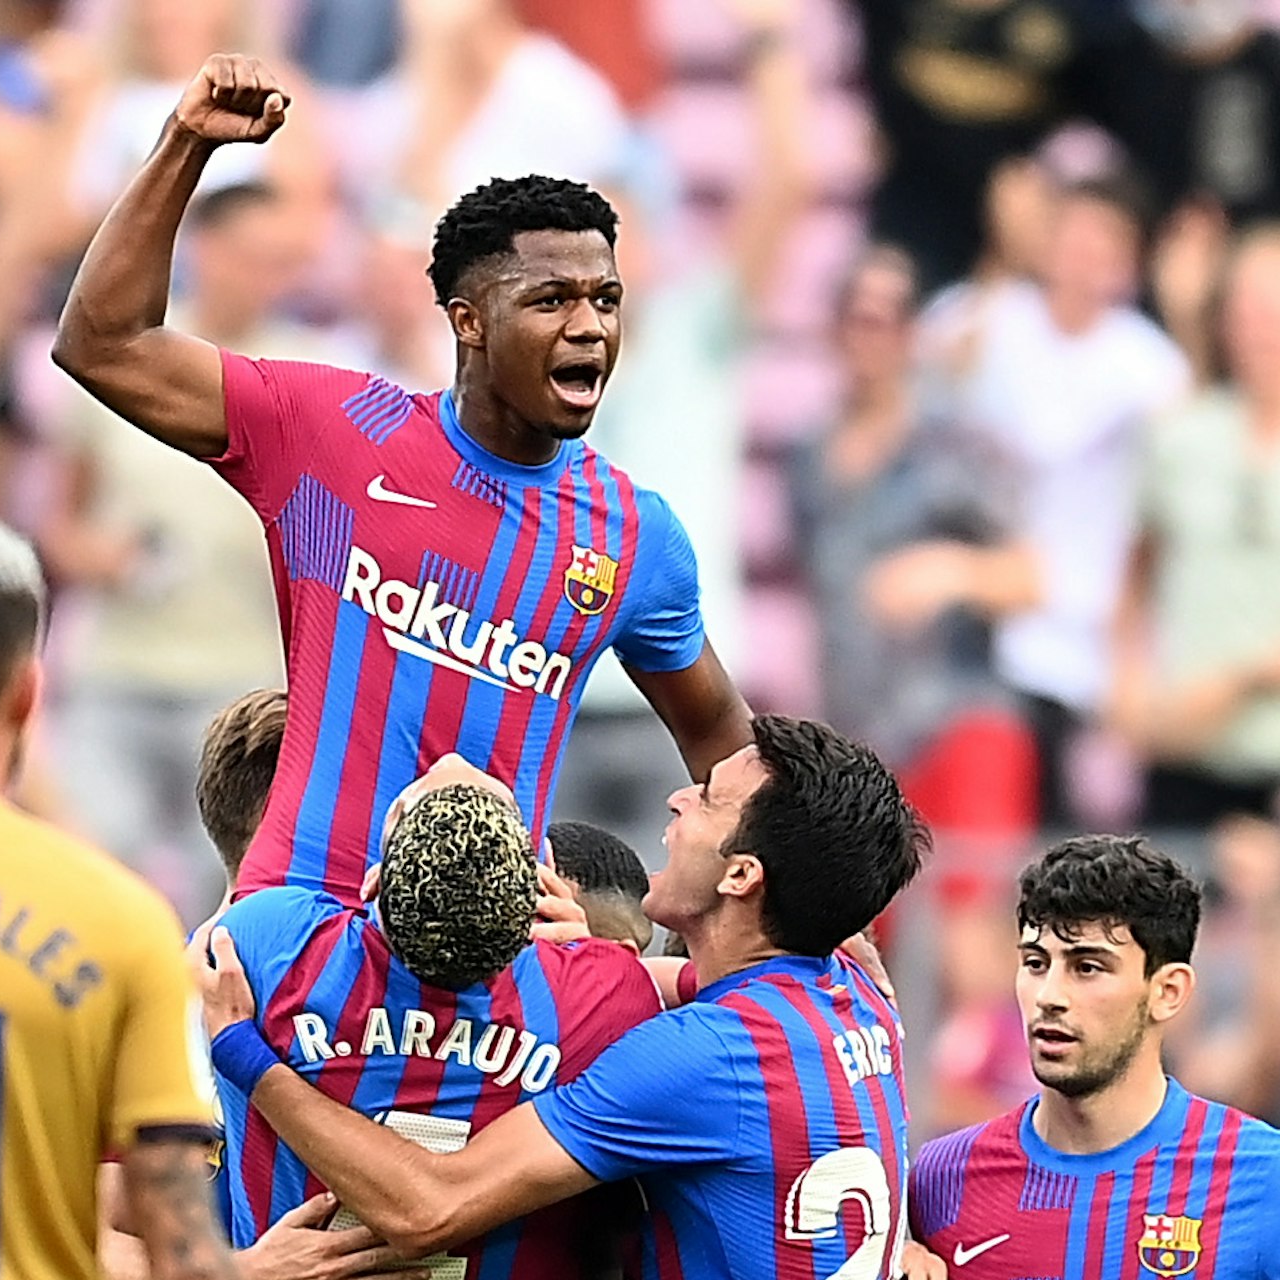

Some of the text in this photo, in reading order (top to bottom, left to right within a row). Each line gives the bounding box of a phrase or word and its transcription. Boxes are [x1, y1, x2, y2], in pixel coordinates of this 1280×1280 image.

[341, 545, 572, 700] Rakuten
[292, 1007, 562, 1094] R. ARAUJO
[832, 1024, 893, 1088] ERIC
